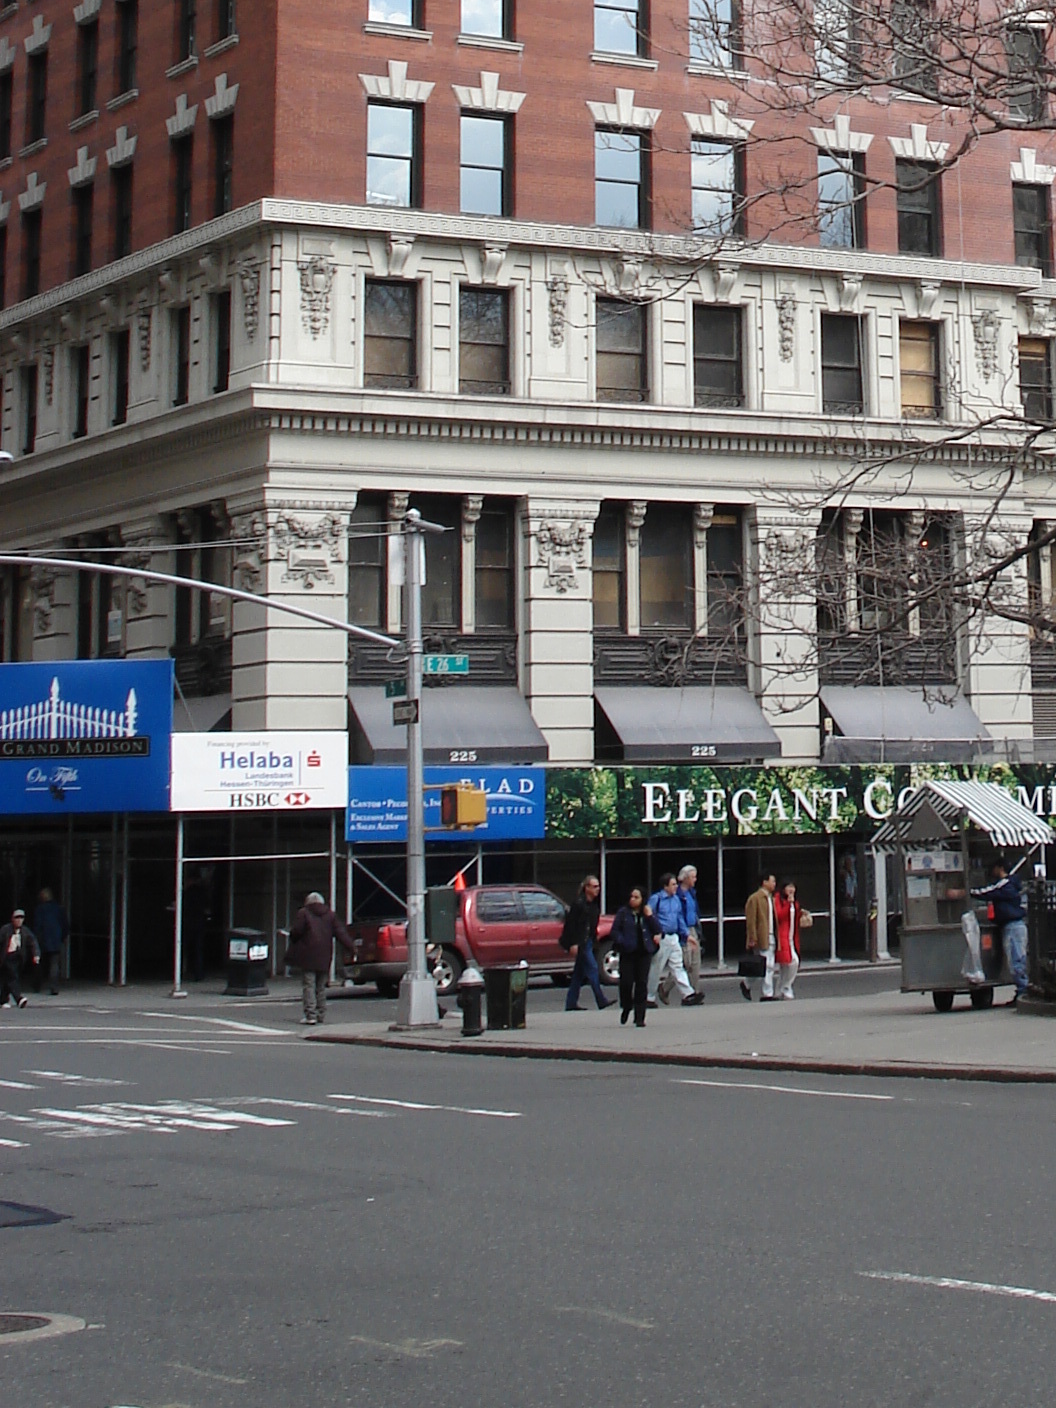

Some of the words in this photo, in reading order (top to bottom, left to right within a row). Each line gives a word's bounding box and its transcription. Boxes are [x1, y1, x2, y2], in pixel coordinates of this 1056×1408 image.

[427, 657, 434, 672] E
[437, 657, 450, 672] 26
[2, 742, 60, 755] GRAND
[66, 741, 143, 754] MADISON
[691, 746, 717, 757] 225
[220, 751, 293, 768] Helaba
[450, 750, 478, 762] 225
[26, 767, 47, 783] On
[245, 772, 294, 780] Landesbank
[220, 779, 294, 788] Hessen-Thüringen
[229, 793, 279, 808] HSBC
[641, 781, 847, 823] ELEGANT
